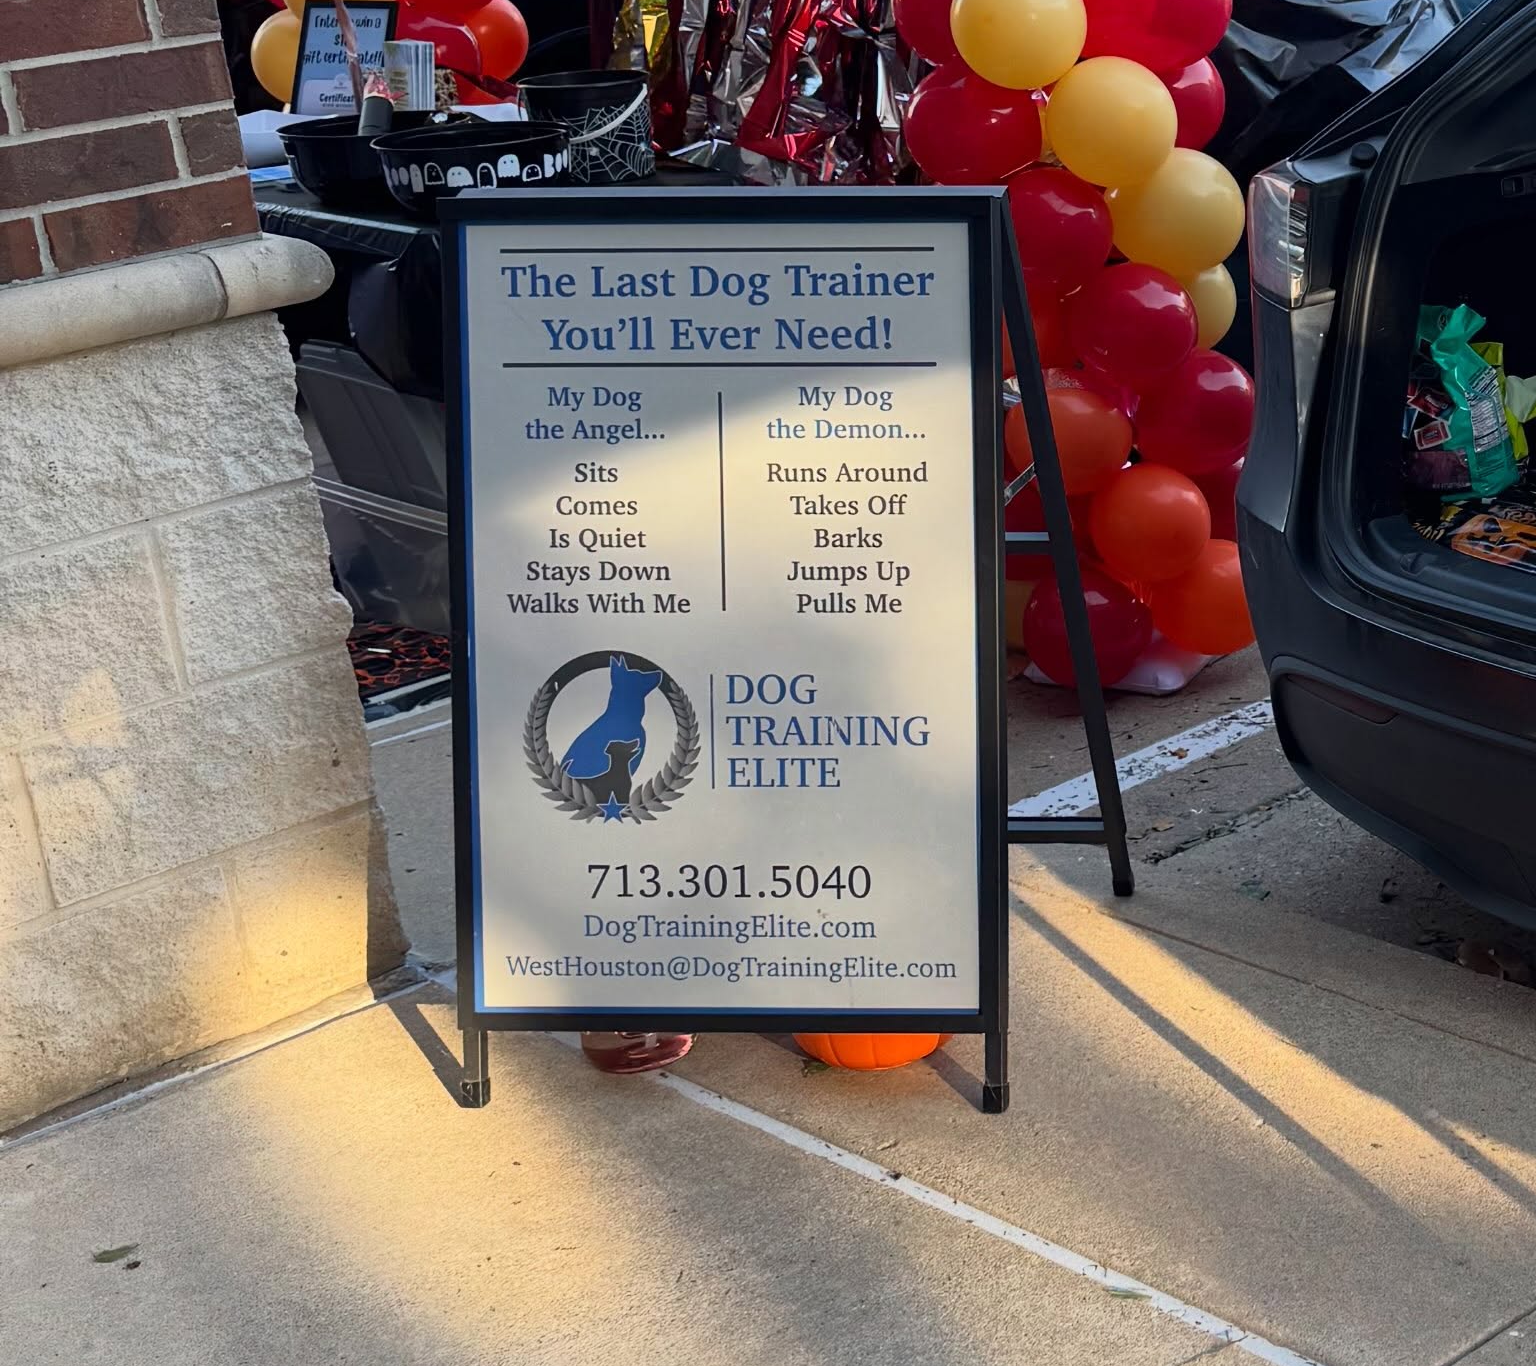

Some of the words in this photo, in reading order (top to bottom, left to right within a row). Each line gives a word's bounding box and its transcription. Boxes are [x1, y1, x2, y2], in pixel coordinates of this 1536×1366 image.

[500, 263, 577, 298] The
[590, 265, 677, 298] Last
[689, 265, 772, 307] Dog
[783, 262, 935, 297] Trainer
[540, 315, 656, 351] You'll
[669, 318, 761, 351] Ever
[774, 314, 893, 351] Need!
[547, 386, 586, 413] My
[592, 386, 643, 413] Dog
[797, 386, 837, 412] My
[843, 386, 894, 412] Dog
[524, 418, 565, 440] the
[571, 417, 666, 446] Angel...
[766, 417, 806, 439] the
[813, 419, 926, 439] Demon...
[574, 461, 619, 483] Sits
[766, 462, 827, 483] Runs
[834, 460, 929, 483] Around
[555, 495, 638, 516] Comes
[789, 493, 859, 516] Takes
[867, 493, 908, 516] Off
[548, 528, 571, 549] Is
[578, 526, 647, 553] Quiet
[813, 526, 883, 549] Barks
[526, 560, 591, 587] Stays
[597, 560, 672, 581] Down
[786, 560, 868, 587] Jumps
[875, 560, 911, 587] Up
[506, 591, 580, 614] Walks
[586, 591, 646, 614] With
[652, 593, 691, 614] Me
[796, 591, 857, 614] Pulls
[864, 593, 903, 614] Me
[725, 673, 818, 705] DOG
[725, 715, 931, 747] TRAINING
[726, 757, 841, 788] ELITE
[587, 864, 872, 900] 713.301.5040
[583, 913, 877, 944] DogTrainingElite.com
[505, 955, 957, 984] WestHouston@DogTrainingElite.com
